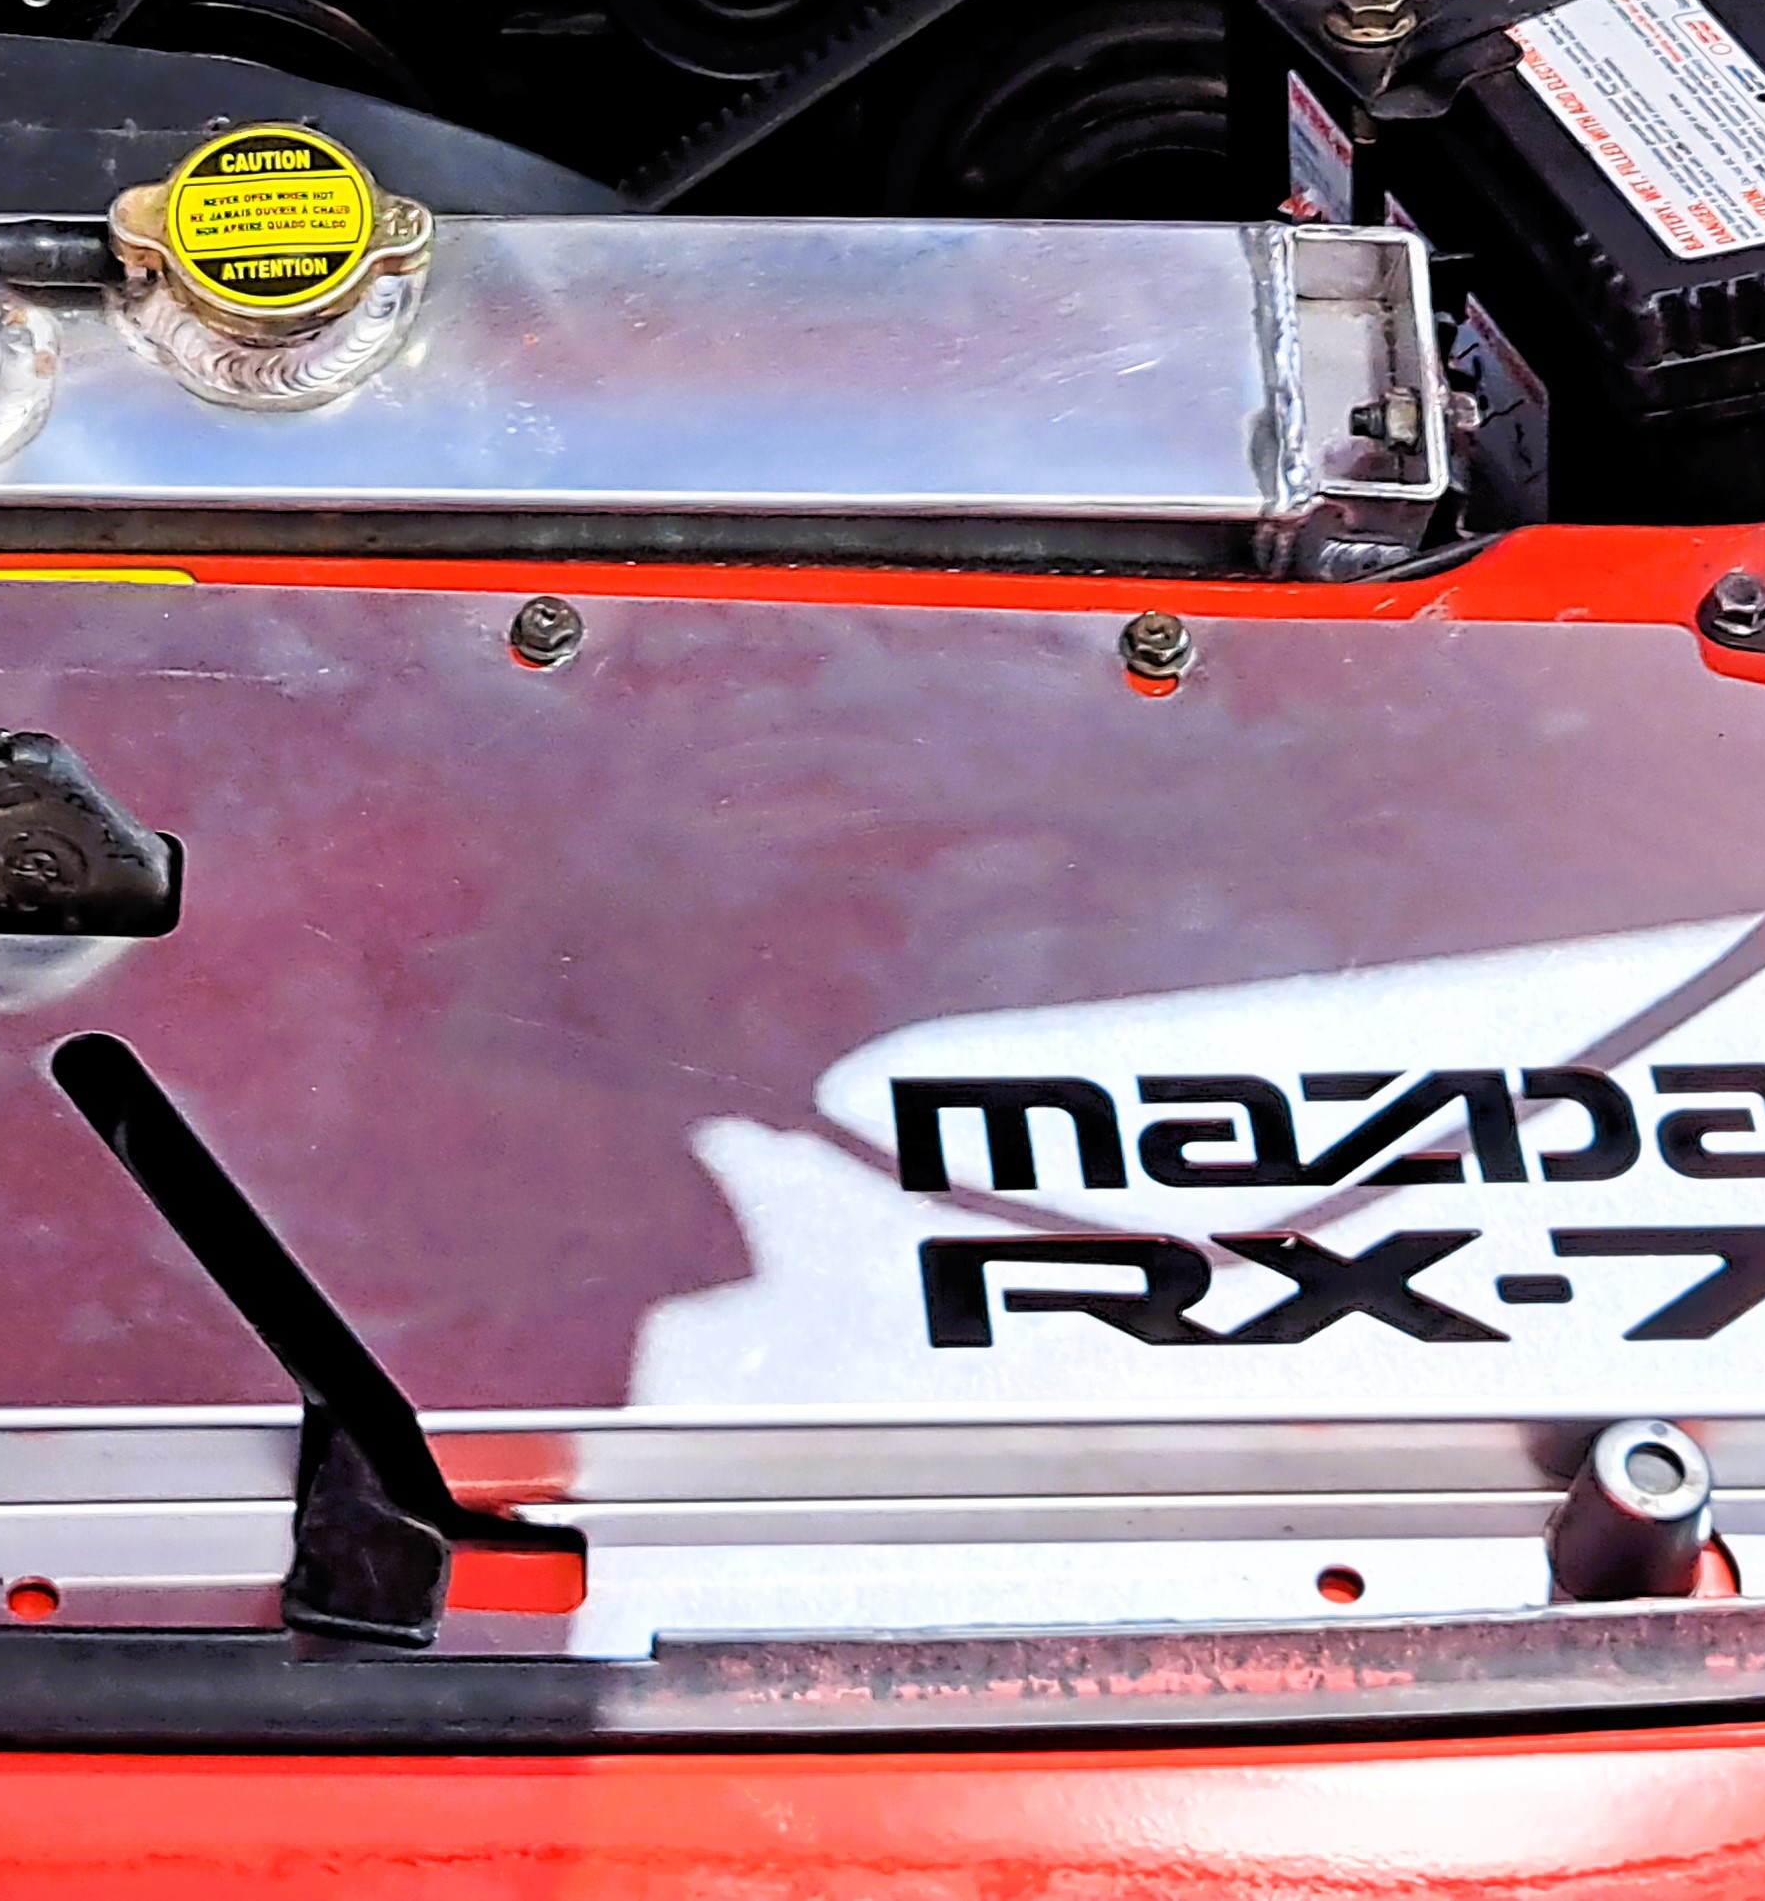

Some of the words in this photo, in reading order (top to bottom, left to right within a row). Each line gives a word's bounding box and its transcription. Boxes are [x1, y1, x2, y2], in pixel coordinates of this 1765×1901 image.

[1556, 90, 1589, 117] ACID
[1575, 114, 1611, 143] WITH
[221, 150, 311, 173] CAUTION
[1598, 142, 1640, 177] FILLED
[203, 195, 239, 206] NEVER
[244, 193, 273, 202] OPEN
[277, 192, 309, 200] WHEN
[313, 191, 334, 200] HOT
[190, 213, 204, 222] NE
[209, 209, 252, 221] JAMAIS
[255, 206, 296, 217] OUVRIR
[313, 205, 350, 215] CHAUD
[196, 226, 219, 236] NON
[222, 257, 328, 281] ATTENTION
